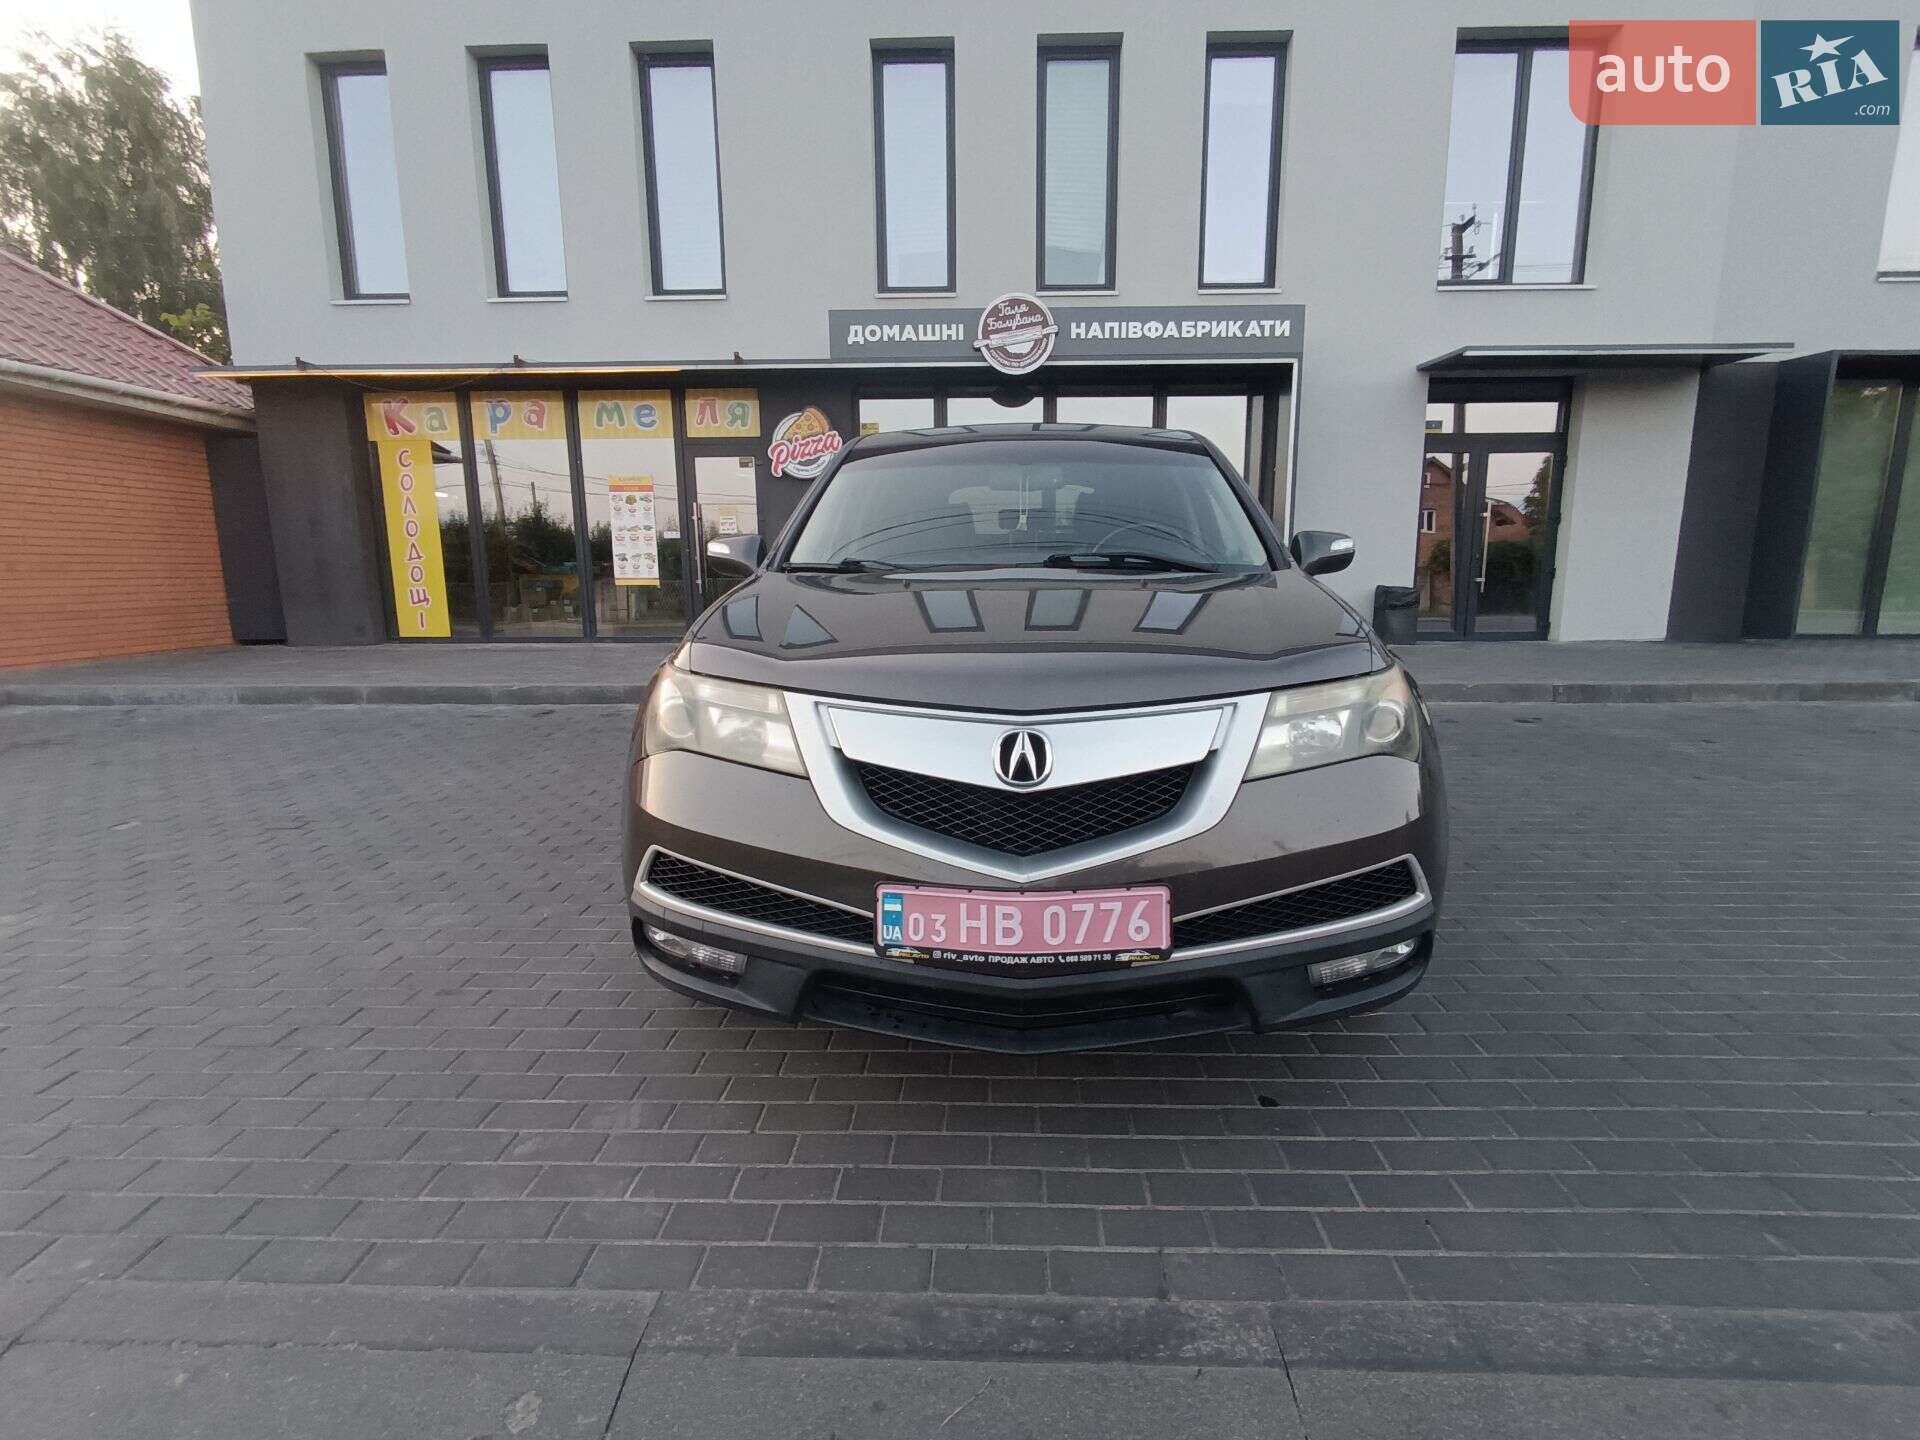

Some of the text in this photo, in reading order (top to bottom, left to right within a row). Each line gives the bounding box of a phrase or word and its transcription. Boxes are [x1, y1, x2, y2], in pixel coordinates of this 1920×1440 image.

[998, 302, 1030, 317] Галя
[986, 313, 1044, 331] Балувана
[847, 319, 1291, 345] ДОМАШНІ НАПІВФАБРИКАТИ
[398, 448, 430, 630] СОЛОДОЩІ
[908, 900, 1151, 946] 03 HB 0776
[883, 925, 902, 940] UA
[988, 955, 1054, 965] ПРОДАЖ АВТО
